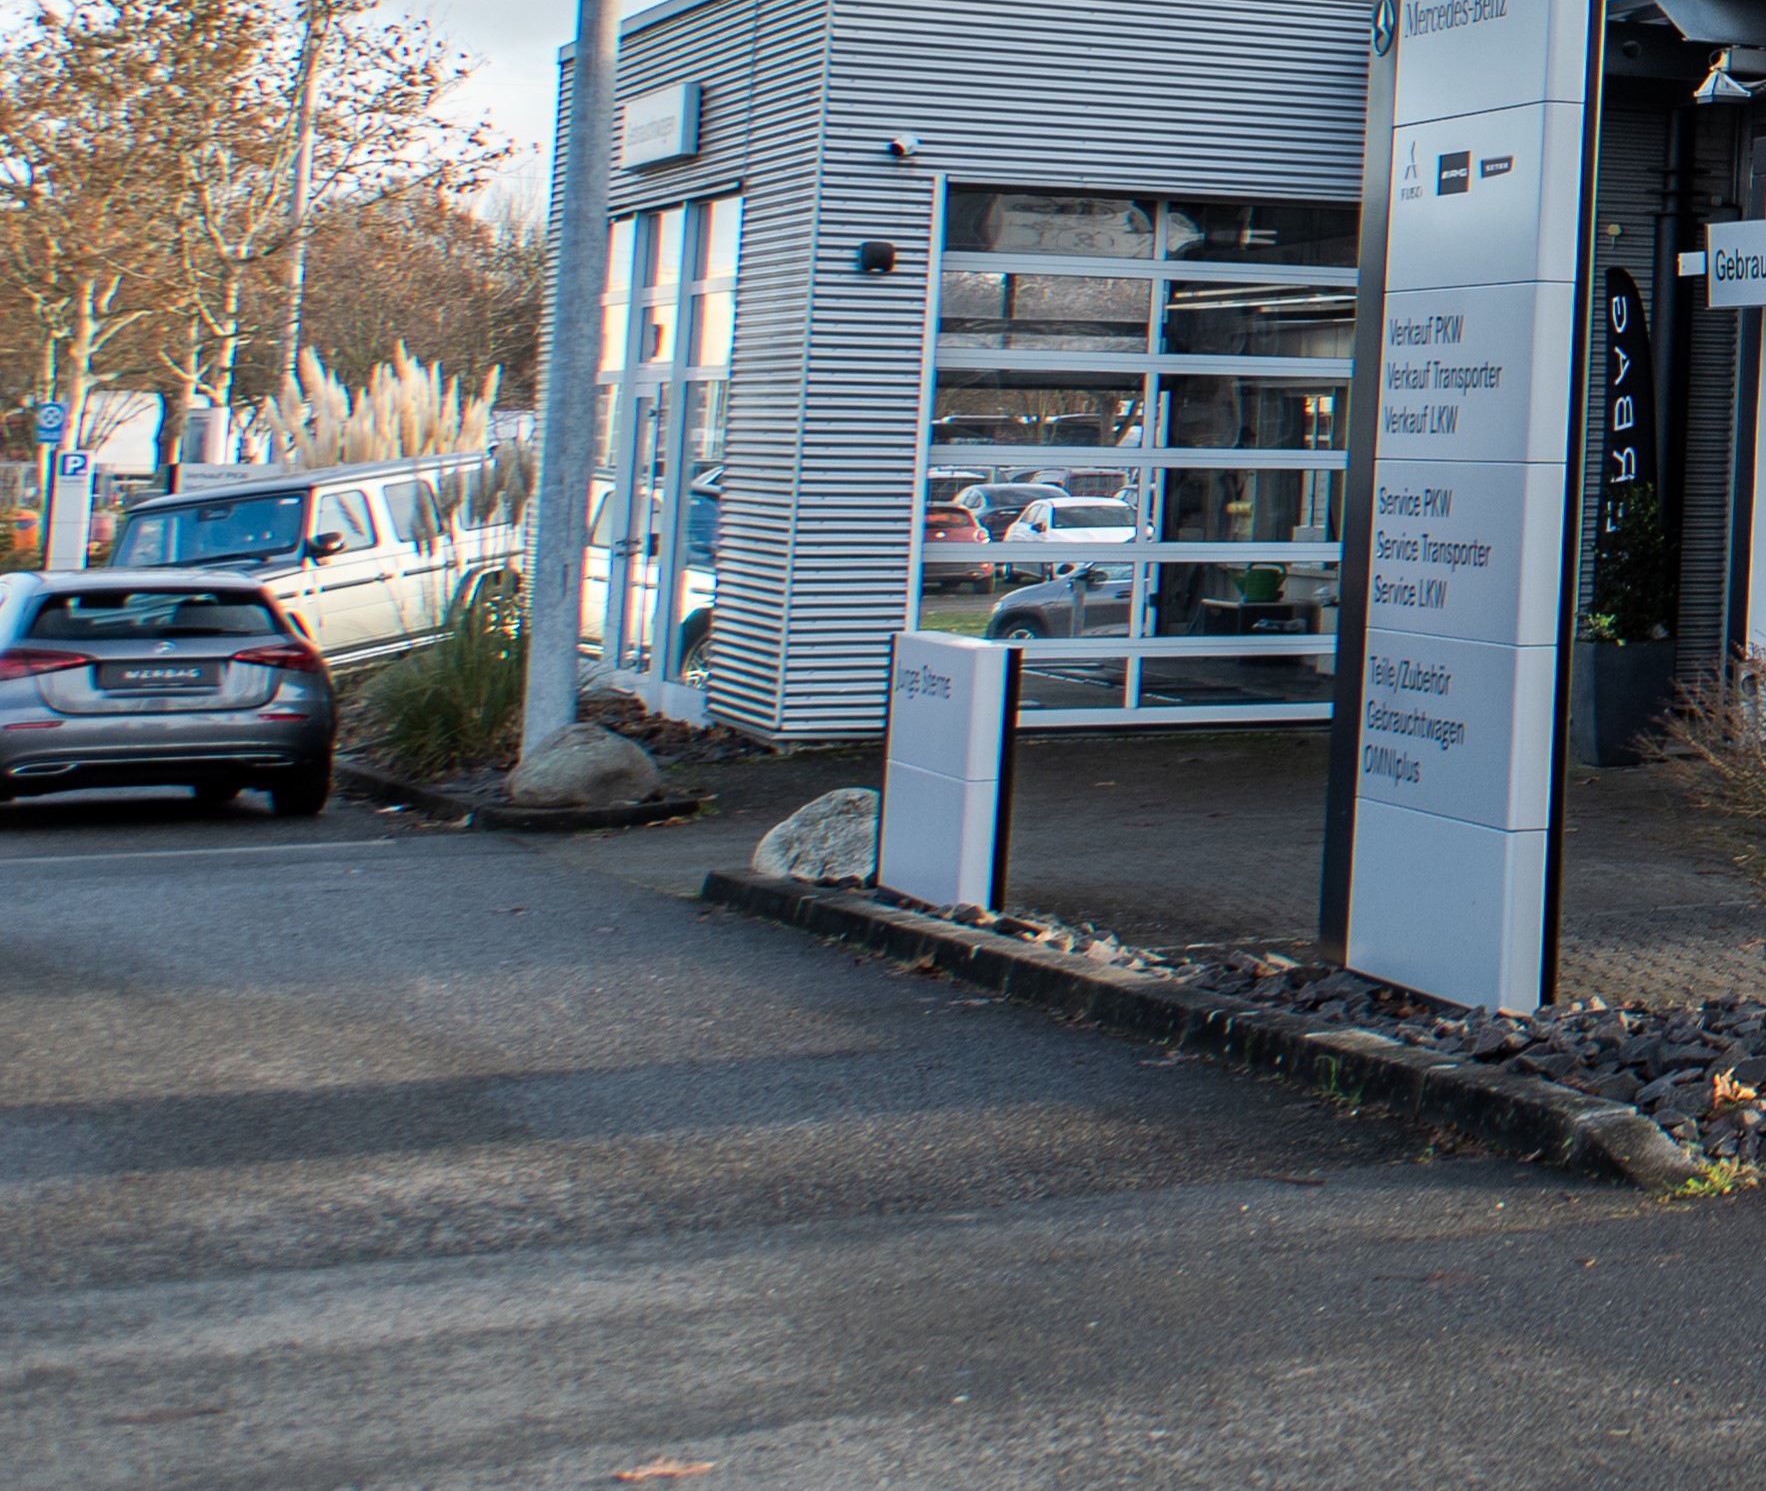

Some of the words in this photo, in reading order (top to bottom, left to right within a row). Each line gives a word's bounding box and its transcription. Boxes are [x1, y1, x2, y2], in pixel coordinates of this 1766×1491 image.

[1390, 316, 1434, 346] Verkauf
[1434, 314, 1464, 344] PKW
[1387, 361, 1431, 390] Verkauf
[1432, 361, 1502, 396] Transporter
[1384, 406, 1429, 435] Verkauf
[1430, 406, 1459, 434] LKW
[1379, 486, 1421, 516] Service
[1423, 488, 1453, 518] PKW
[1377, 530, 1418, 561] Service
[1421, 533, 1492, 573] Transporter
[1374, 574, 1416, 607] Service
[1418, 578, 1448, 609] LKW
[1370, 655, 1452, 696] Teile/Zubehör
[1366, 699, 1466, 752] Gebrauchtwagen
